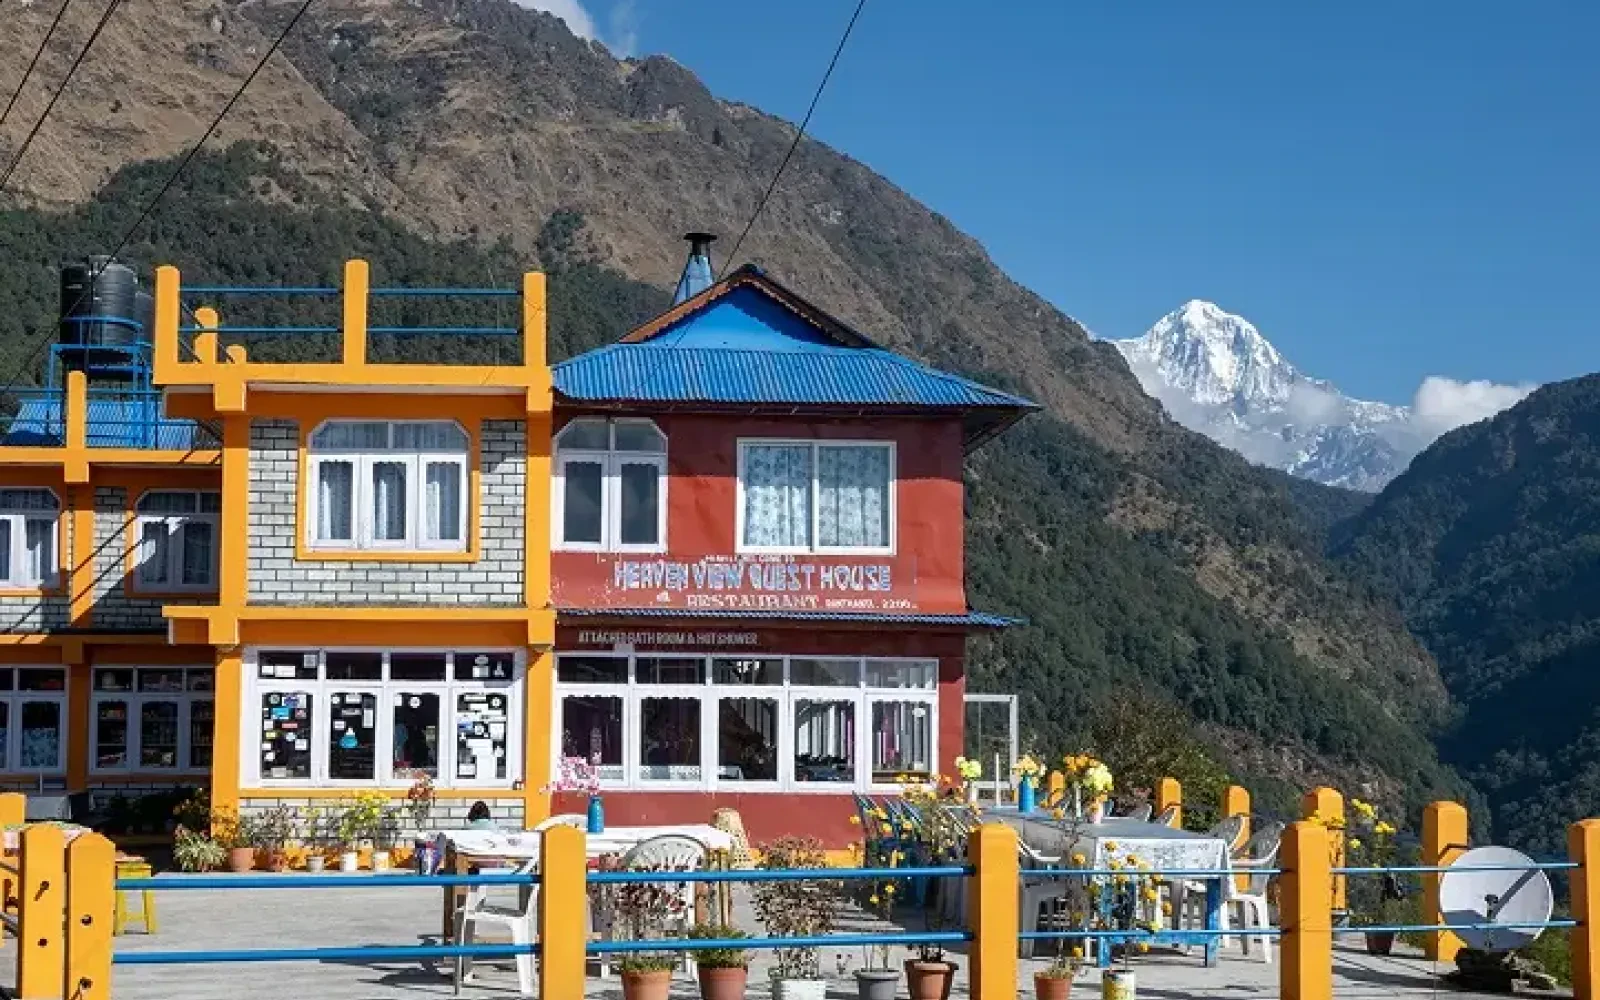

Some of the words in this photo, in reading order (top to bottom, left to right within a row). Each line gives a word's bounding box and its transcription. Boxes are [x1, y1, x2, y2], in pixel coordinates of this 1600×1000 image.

[614, 559, 689, 592] HEAVEN
[692, 559, 744, 590] VIEW
[820, 564, 891, 591] HOUSE
[686, 594, 819, 608] RESTAURANT
[628, 632, 655, 645] BATH
[656, 632, 685, 645] ROOM
[697, 632, 716, 645] HOT
[717, 632, 758, 645] SHOWER
